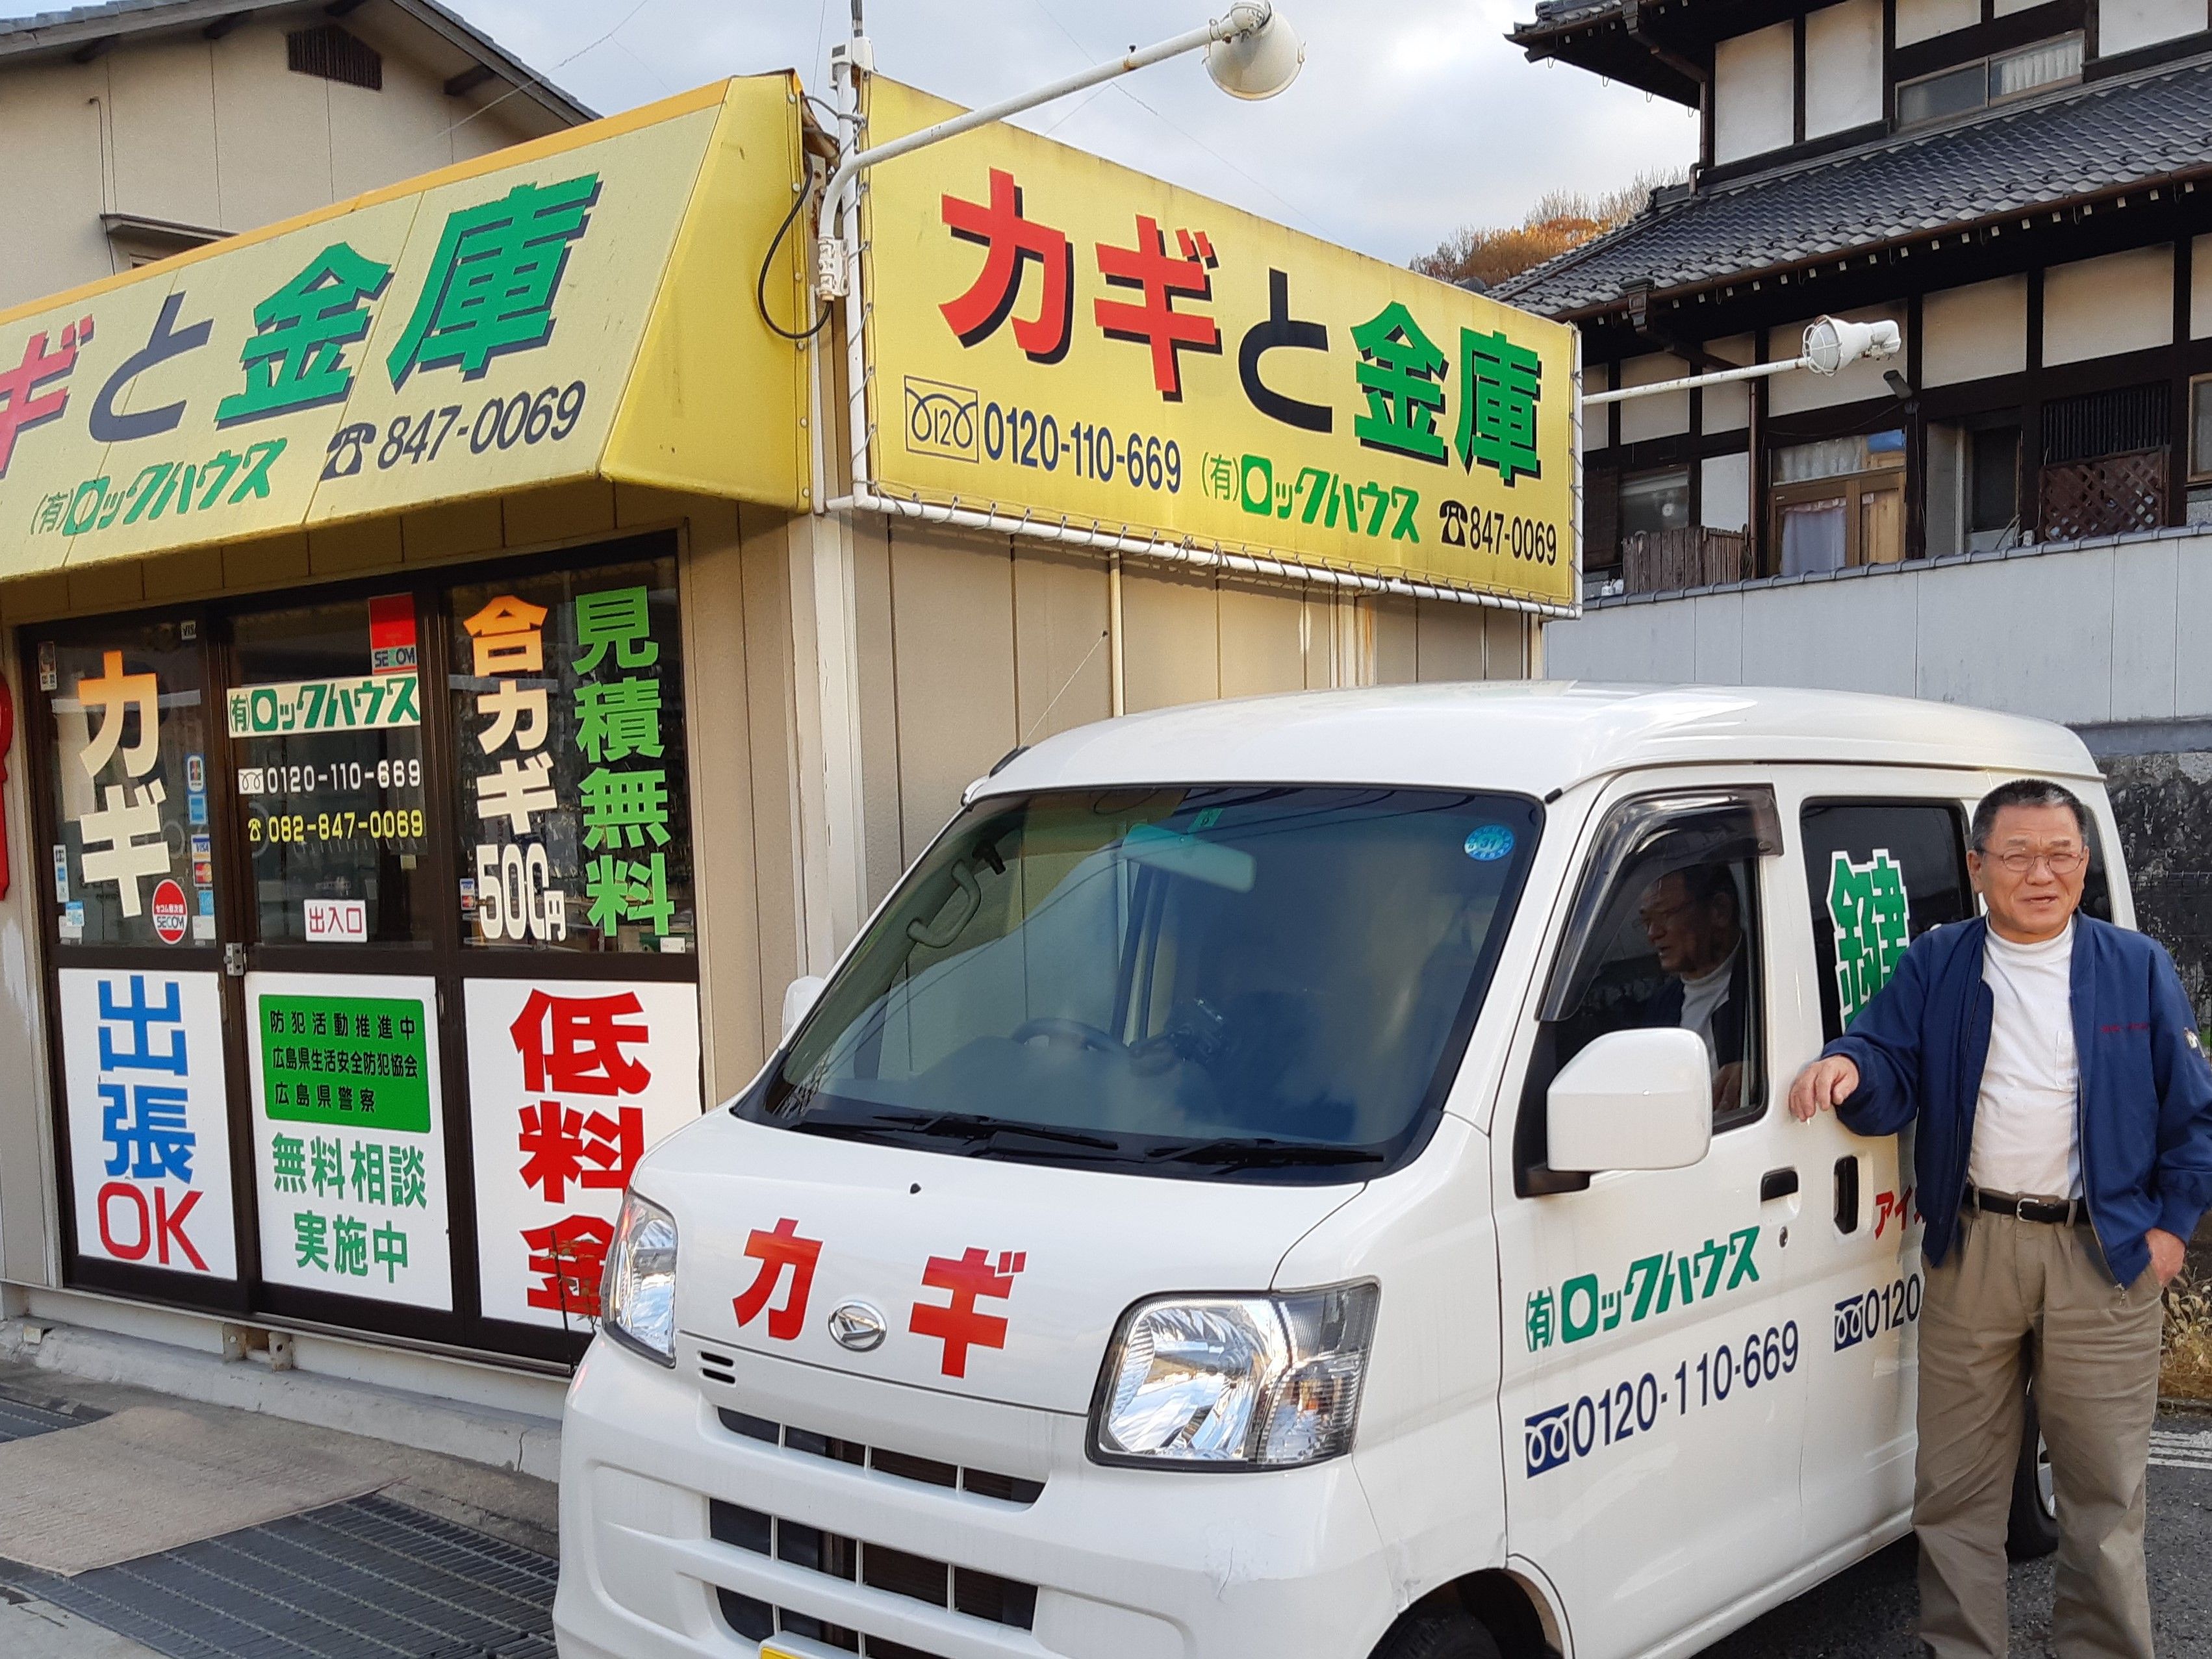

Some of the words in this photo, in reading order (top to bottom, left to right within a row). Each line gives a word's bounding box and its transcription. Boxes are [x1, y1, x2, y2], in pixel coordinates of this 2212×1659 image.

[939, 168, 1544, 487] カギと金庫
[378, 379, 587, 470] 847-0069
[984, 401, 1182, 494] 0120-110-669
[1469, 505, 1557, 566] 847-0069
[374, 647, 415, 668] SECOM
[463, 594, 558, 835] 合カギ
[77, 650, 172, 918] カギ
[267, 759, 421, 794] 0120-110-669
[572, 585, 675, 938] 見積無料
[268, 809, 423, 843] 082-847-0069
[157, 916, 184, 929] SECOM
[309, 905, 362, 933] 出入口
[476, 843, 567, 941] 500円
[270, 1008, 415, 1041] 防犯活動推進中
[97, 974, 196, 1183] 出張
[272, 1044, 418, 1079] 広島県生活安全防犯協会
[274, 1080, 375, 1113] 広島県警察
[272, 1131, 428, 1209] 無料相談
[510, 987, 652, 1317] 低料金
[97, 1181, 210, 1272] OK
[293, 1211, 409, 1284] 実施中
[1874, 1184, 1926, 1241] アイ
[1864, 1273, 1921, 1339] 0120
